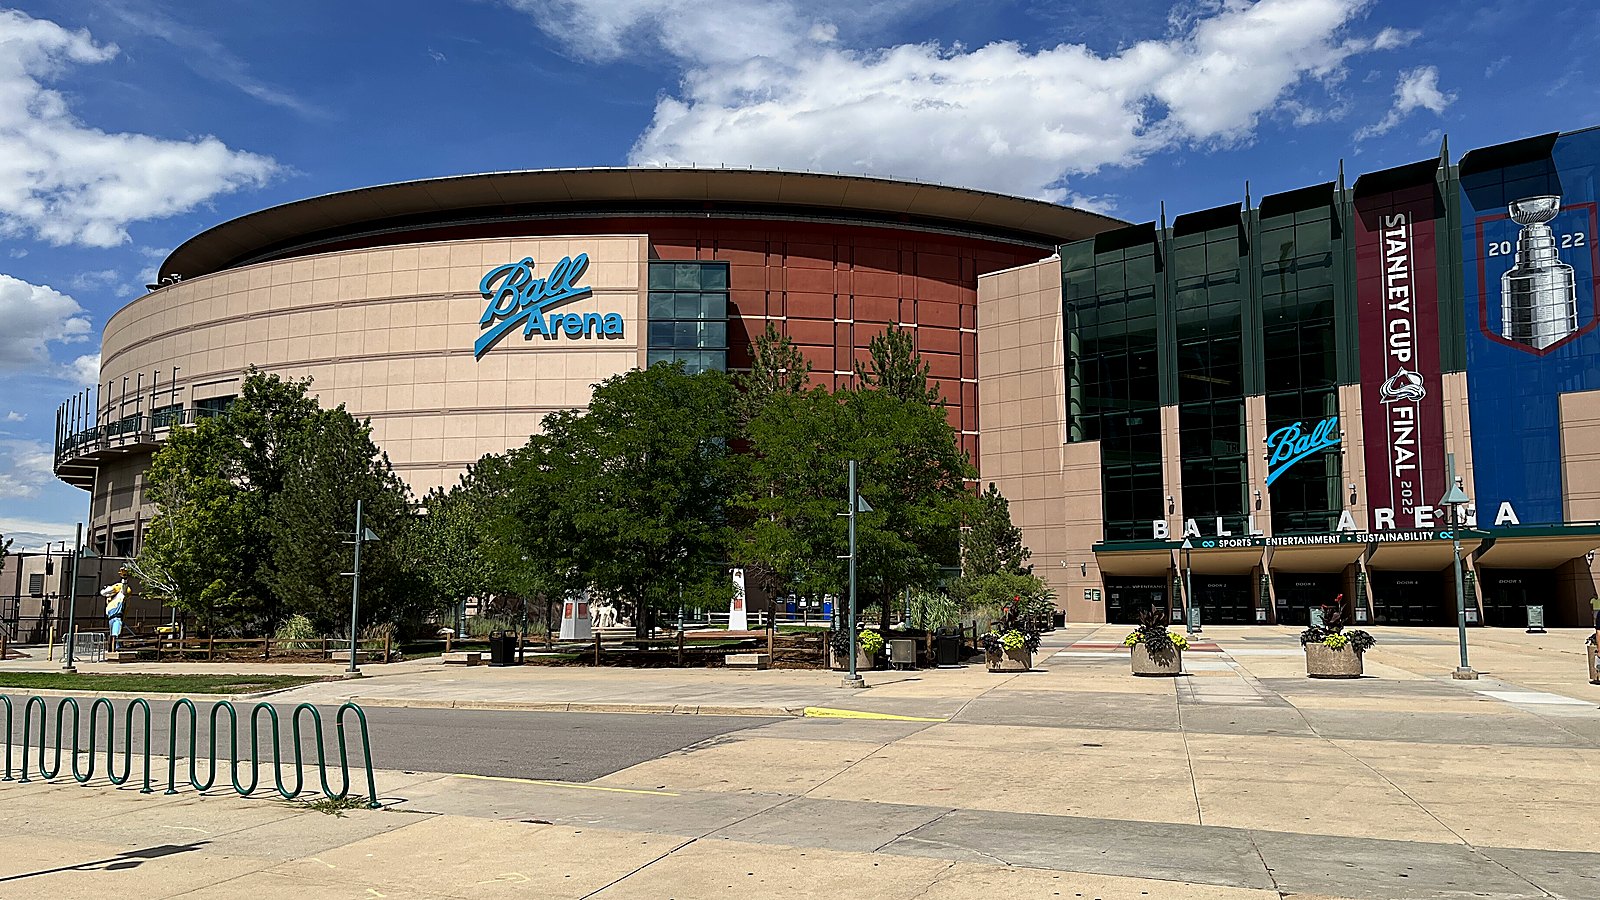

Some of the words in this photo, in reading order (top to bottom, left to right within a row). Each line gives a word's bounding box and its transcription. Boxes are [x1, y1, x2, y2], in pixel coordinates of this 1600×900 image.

[1385, 213, 1410, 313] STANLEY
[1488, 241, 1511, 257] 20
[1561, 232, 1585, 249] 22
[475, 252, 593, 358] Ball
[523, 307, 625, 341] Arena
[1389, 318, 1411, 363] CUP
[1266, 416, 1341, 487] Ball
[1392, 406, 1416, 478] FINAL
[1401, 481, 1414, 515] 2022
[1153, 515, 1264, 540] BALL
[1218, 538, 1252, 548] SPORTS
[1265, 535, 1341, 546] ENTERTAINMENT
[1356, 531, 1434, 543] SUSTAINABILITY
